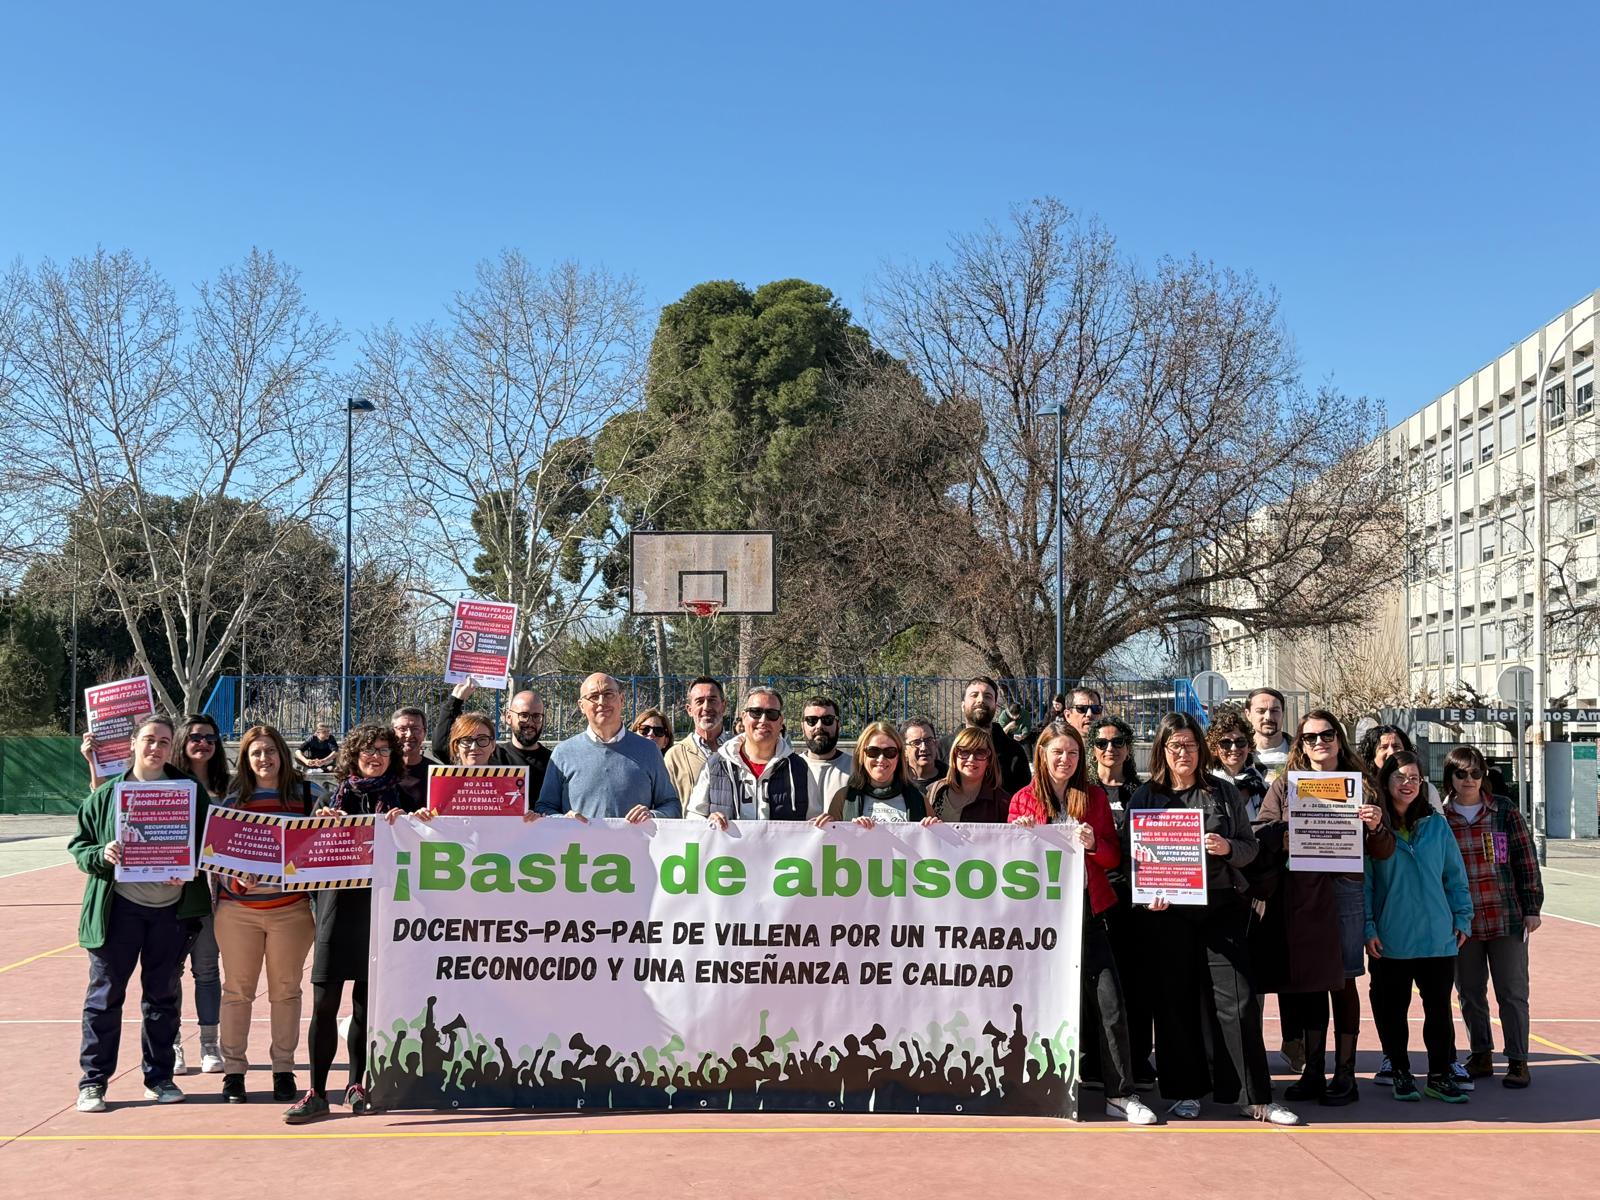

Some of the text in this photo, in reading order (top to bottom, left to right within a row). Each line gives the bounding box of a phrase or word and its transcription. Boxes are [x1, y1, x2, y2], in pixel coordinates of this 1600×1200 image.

[460, 604, 470, 615] 7
[468, 611, 512, 620] MOBILITZACIÓ
[90, 692, 99, 704] 7
[99, 689, 147, 703] MOBILITZACIÓ
[124, 793, 135, 806] 7
[1136, 815, 1147, 827] 7
[234, 832, 275, 843] RETALLADES
[313, 839, 356, 847] RETALLADES
[226, 846, 277, 858] PROFESSIONAL
[243, 841, 280, 851] FORMACIÓ
[325, 846, 363, 854] FORMACIÓ
[309, 855, 361, 863] PROFESSIONAL
[392, 841, 1063, 902] ¡Basta de abusos!
[672, 921, 705, 946] DE
[715, 922, 820, 947] VILLENA
[830, 924, 880, 948] POR
[890, 925, 924, 948] UN
[935, 925, 1058, 951] TRABAJO
[436, 953, 1014, 988] RECONOCIDO Y UNA ENSEÑANZA DE CALIDAD
